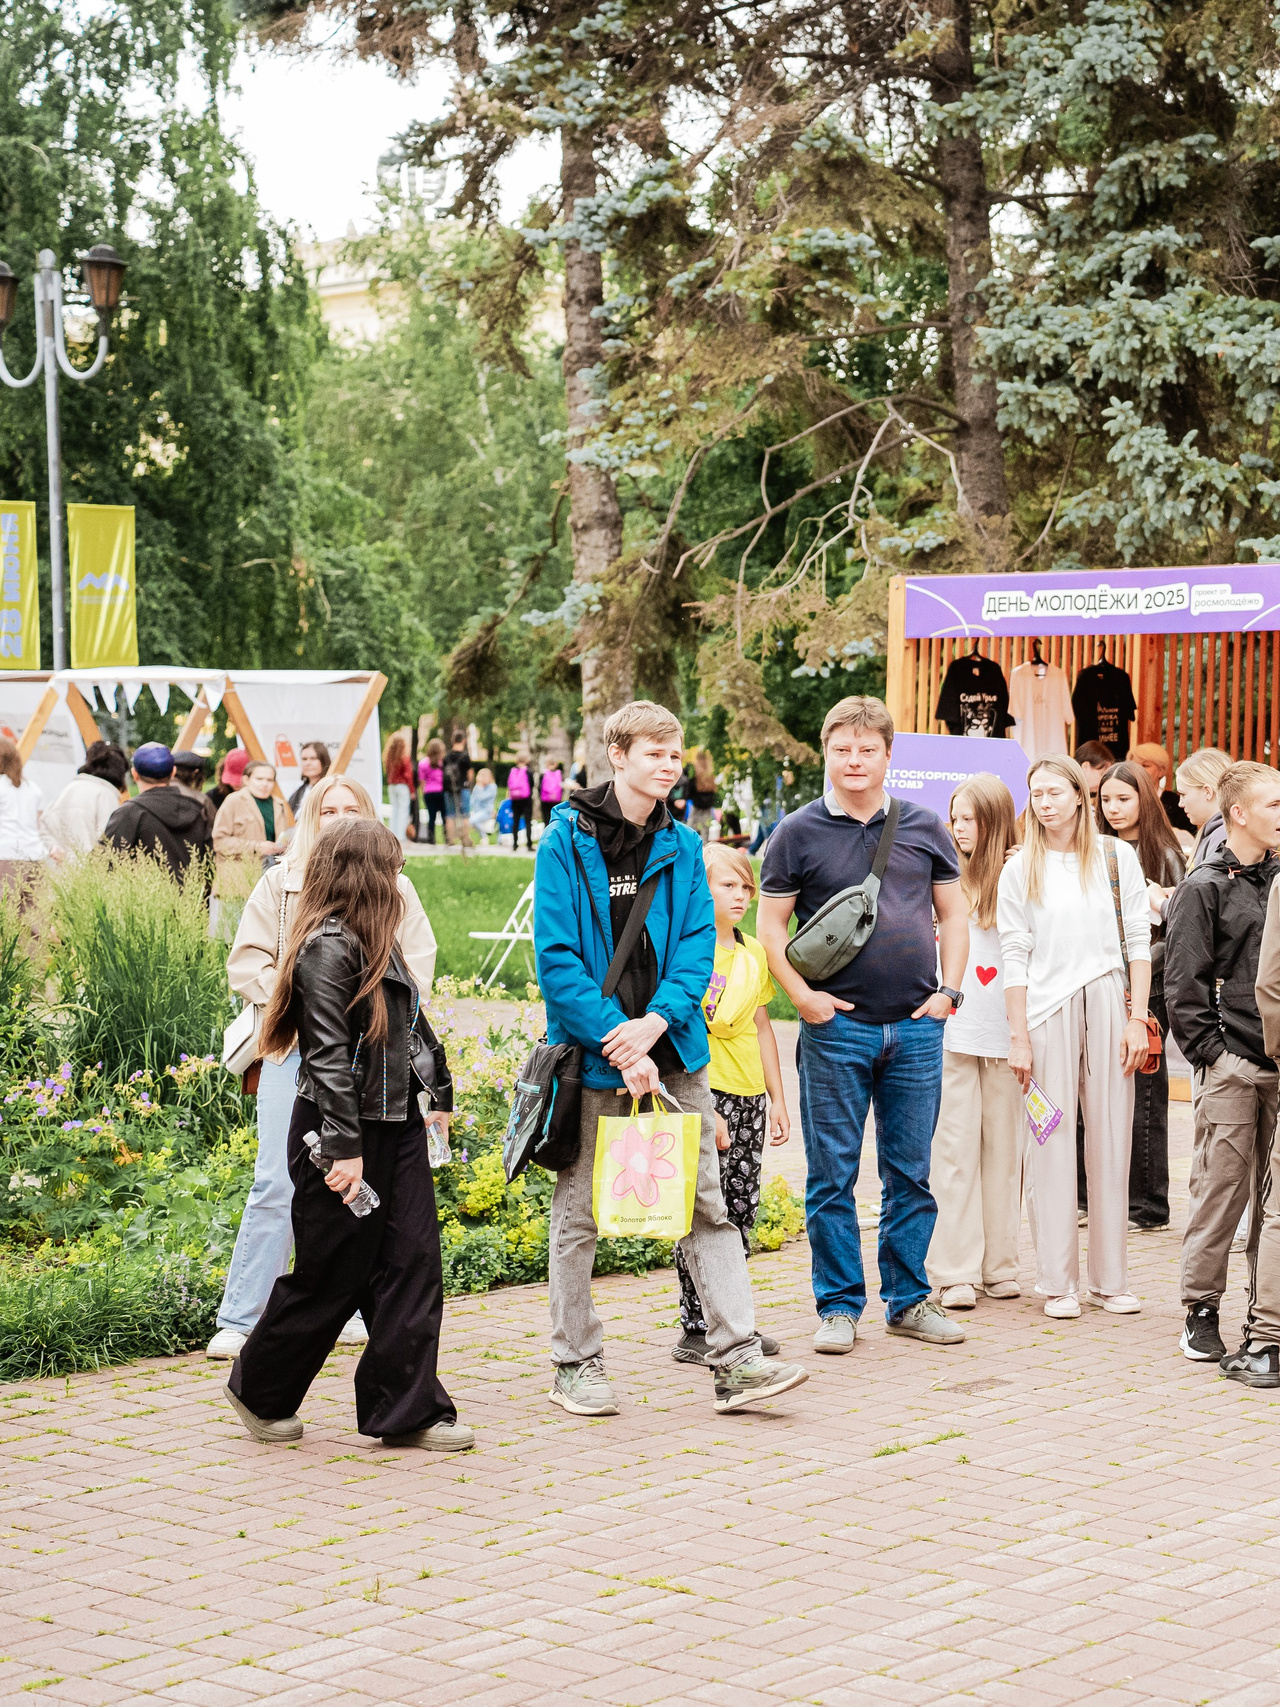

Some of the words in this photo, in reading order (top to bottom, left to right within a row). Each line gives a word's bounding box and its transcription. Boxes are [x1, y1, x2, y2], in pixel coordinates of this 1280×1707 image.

[1194, 588, 1218, 598] проект
[985, 595, 1031, 615] ДЕНЬ
[1034, 589, 1139, 615] МОЛОДЁЖИ
[1144, 588, 1185, 610] 2025
[1193, 596, 1260, 610] росмолодёжь
[892, 768, 1000, 782] ГОСКОРПОРА
[882, 778, 924, 790] АТОМ»
[609, 882, 637, 898] STRE
[647, 1214, 673, 1222] Яблоко
